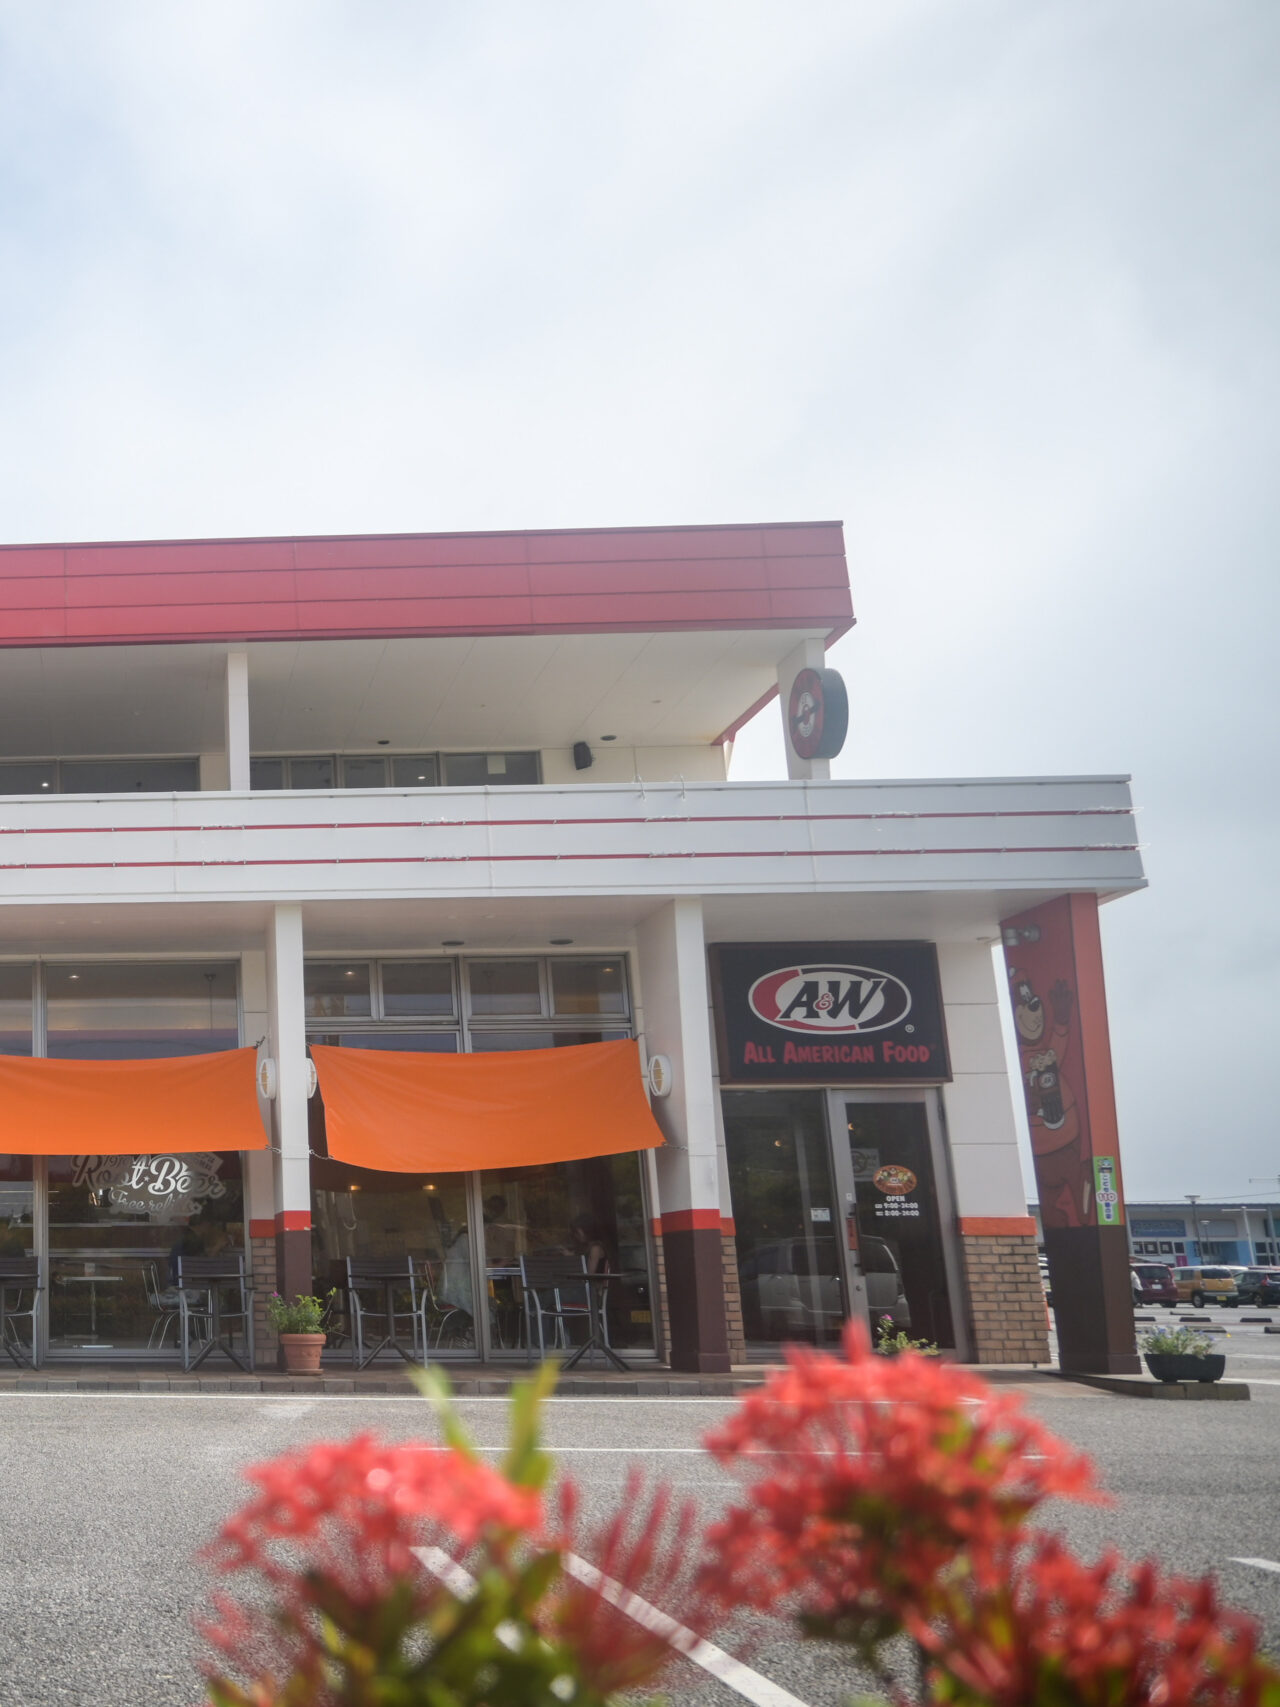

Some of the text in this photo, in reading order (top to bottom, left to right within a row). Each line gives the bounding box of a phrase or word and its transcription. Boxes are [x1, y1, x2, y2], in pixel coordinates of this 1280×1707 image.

[778, 979, 883, 1020] A&W
[743, 1041, 931, 1064] ALL AMERICAN FOOD
